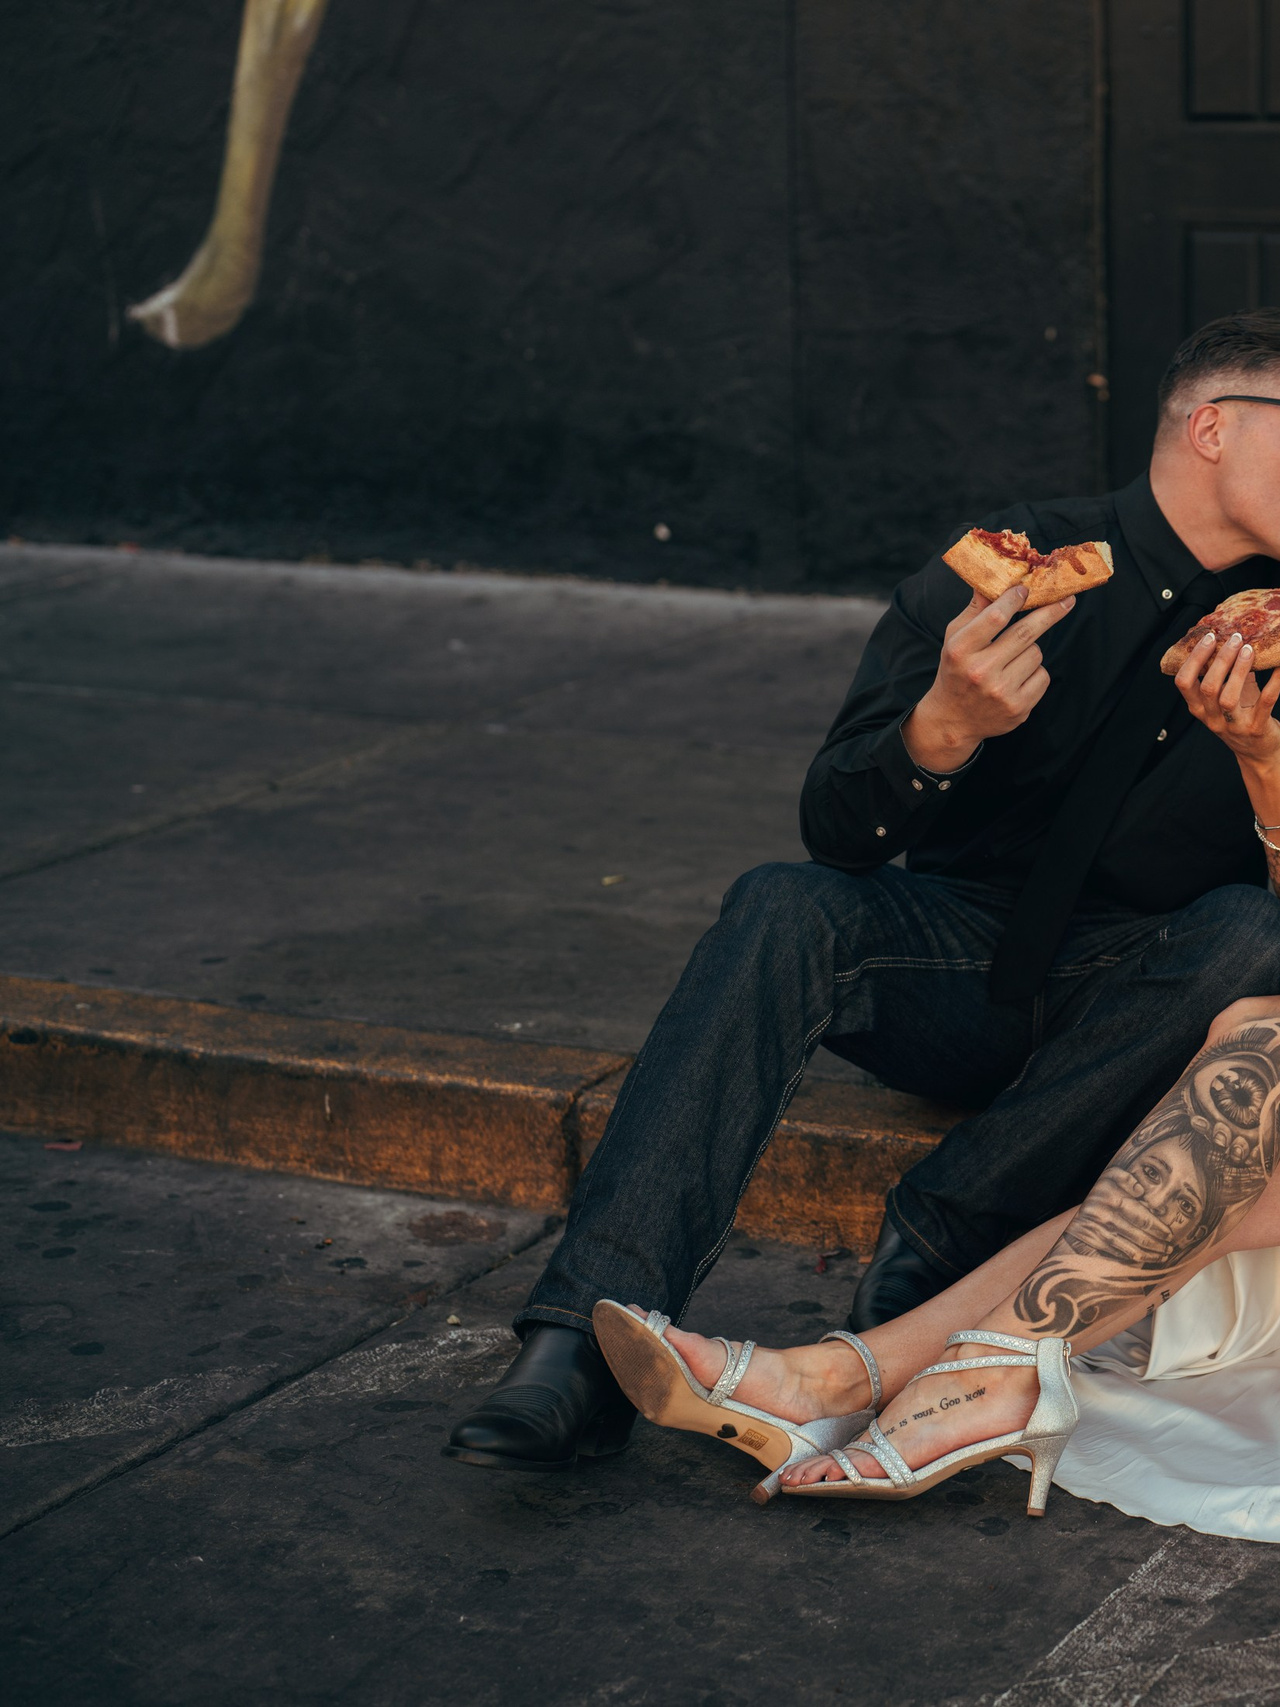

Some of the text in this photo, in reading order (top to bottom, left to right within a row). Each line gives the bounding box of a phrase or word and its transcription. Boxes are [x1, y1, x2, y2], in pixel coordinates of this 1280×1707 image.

[899, 1419, 908, 1428] IS
[912, 1407, 938, 1420] YOUR
[965, 1387, 986, 1402] NOW
